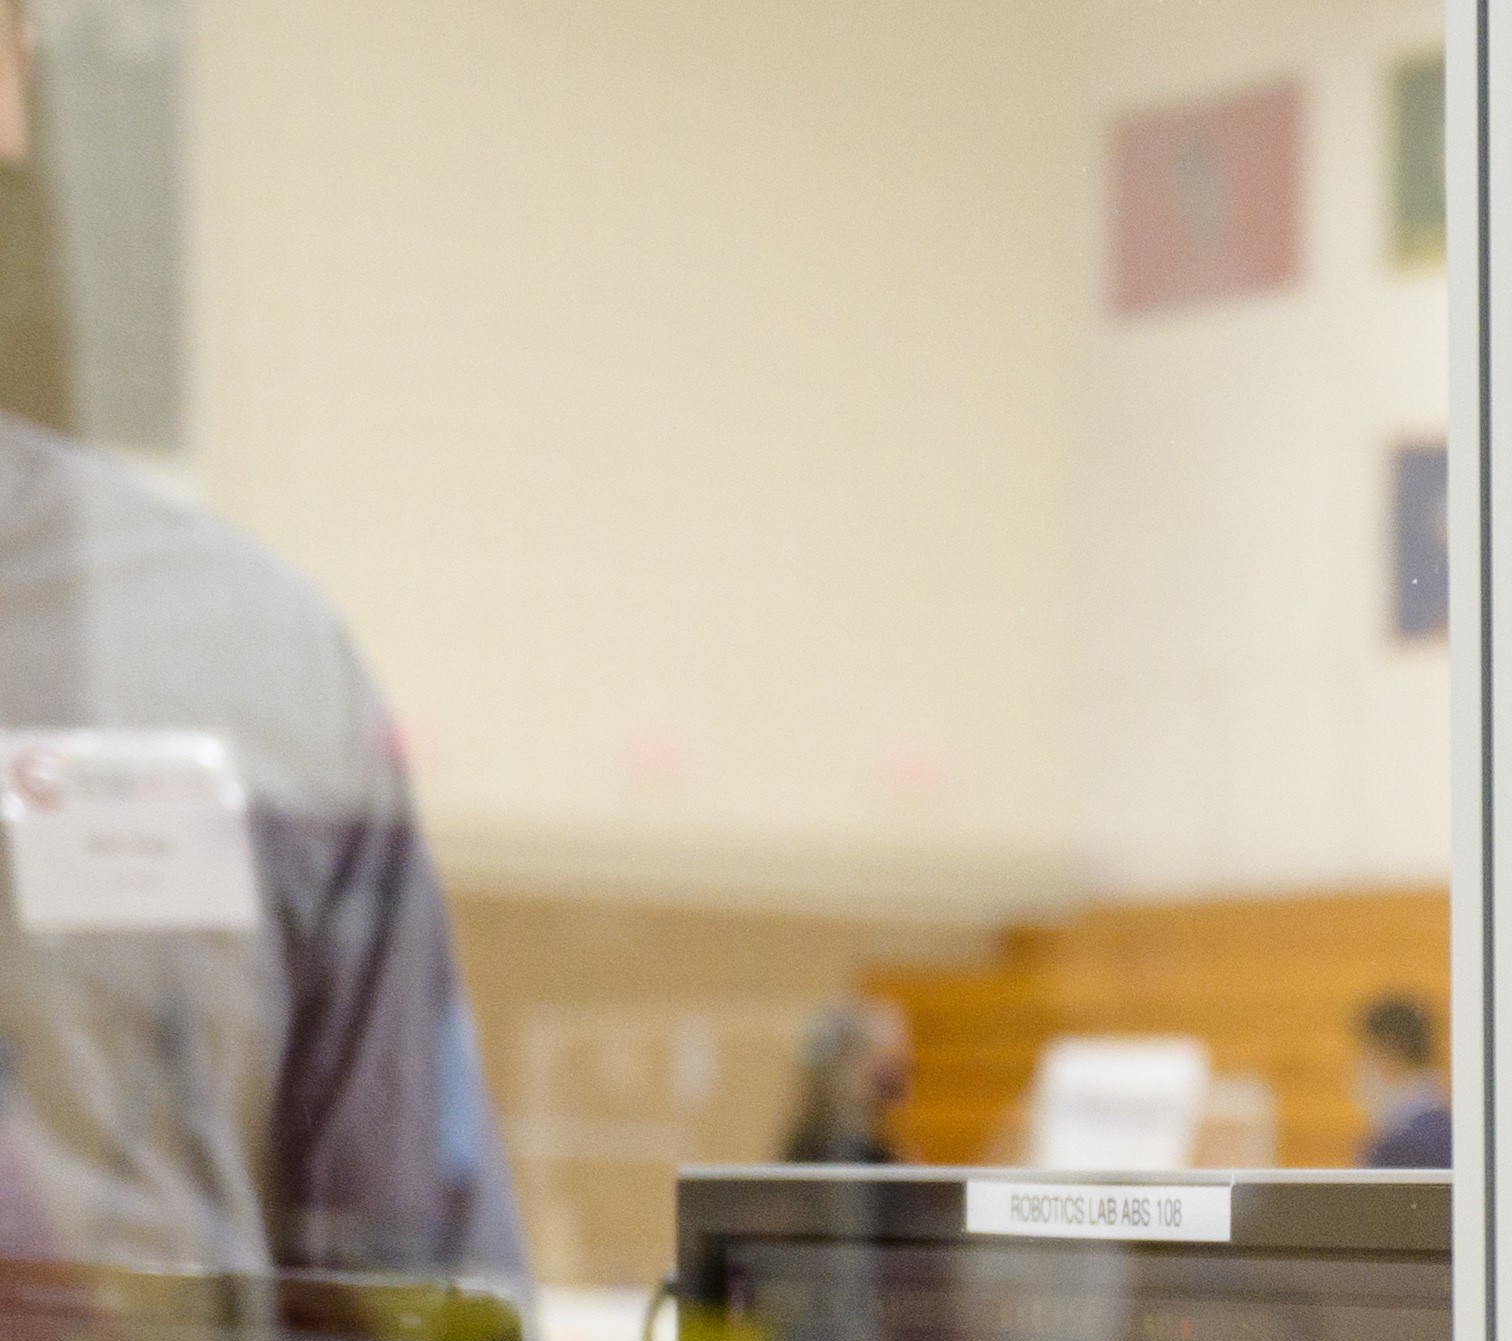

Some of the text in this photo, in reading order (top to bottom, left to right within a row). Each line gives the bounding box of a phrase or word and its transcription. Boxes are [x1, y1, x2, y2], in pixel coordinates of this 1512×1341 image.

[1010, 1193, 1182, 1228] ROBOTICS LAB ABS 108
